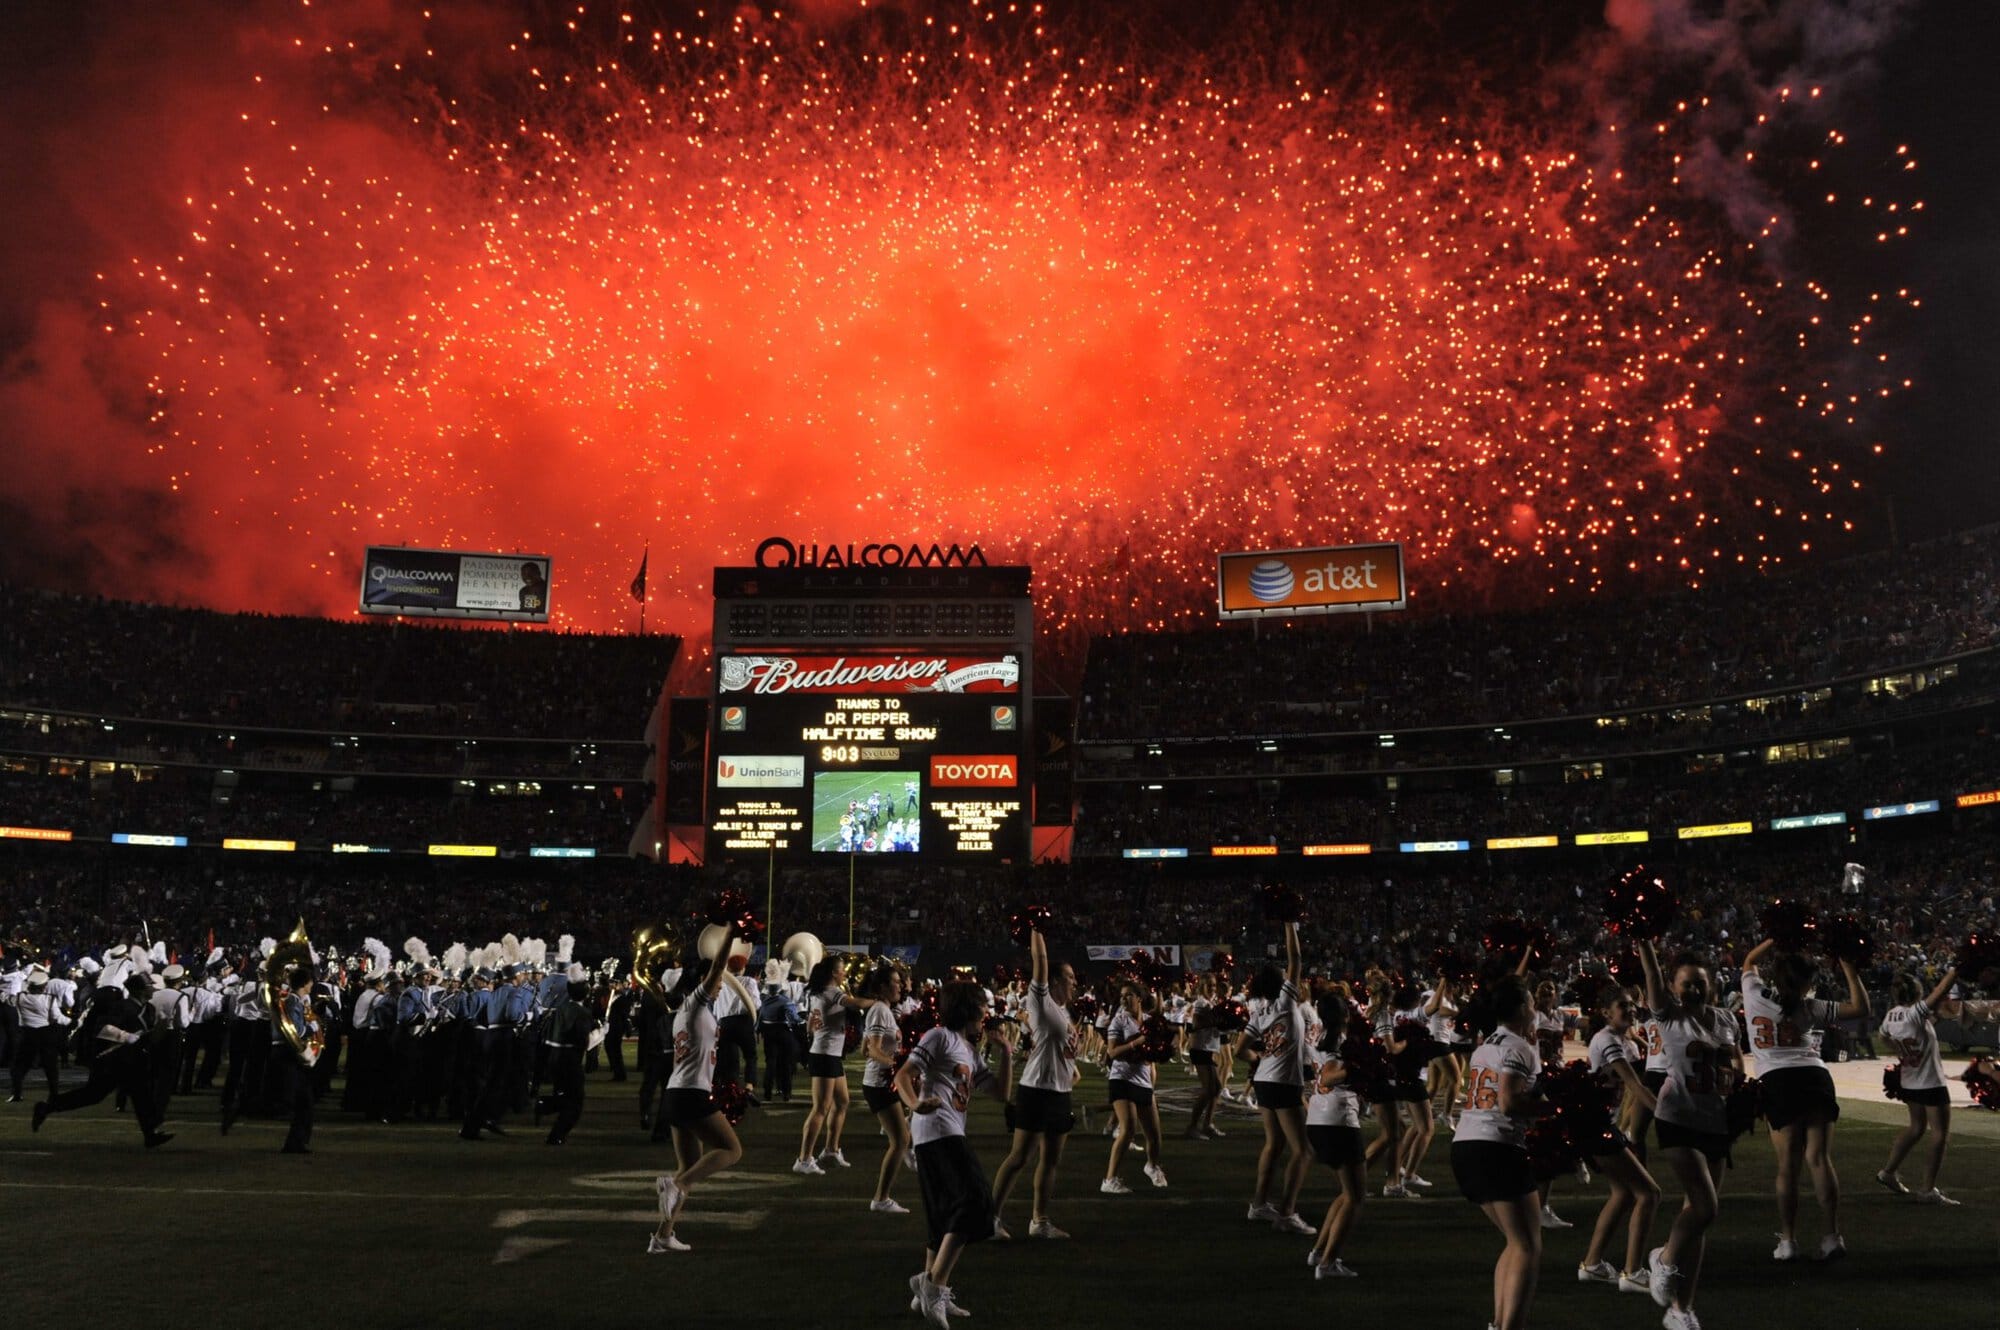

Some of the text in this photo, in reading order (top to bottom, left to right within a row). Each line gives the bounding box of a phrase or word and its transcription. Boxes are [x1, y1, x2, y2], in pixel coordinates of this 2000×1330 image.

[755, 537, 988, 567] QUALCOMM
[463, 560, 519, 572] PALOMAR
[371, 565, 454, 583] QUALCOMM
[463, 570, 520, 581] POMERADO
[1303, 560, 1378, 592] at&t
[463, 580, 519, 590] HEALTH
[746, 656, 948, 694] Budweiser
[949, 667, 1017, 688] American Lager
[836, 699, 900, 710] THANKS TO
[825, 712, 910, 725] DR PEPPER
[803, 728, 937, 740] HALFTIME SHOW
[822, 746, 859, 762] 9:03
[740, 767, 802, 777] UnionBank
[934, 764, 1013, 779] TOYOTA
[952, 802, 993, 810] PACIFIC
[996, 802, 1020, 810] LIFE
[1957, 793, 1994, 807] WELLS
[1212, 846, 1277, 855] WELLS FARGO
